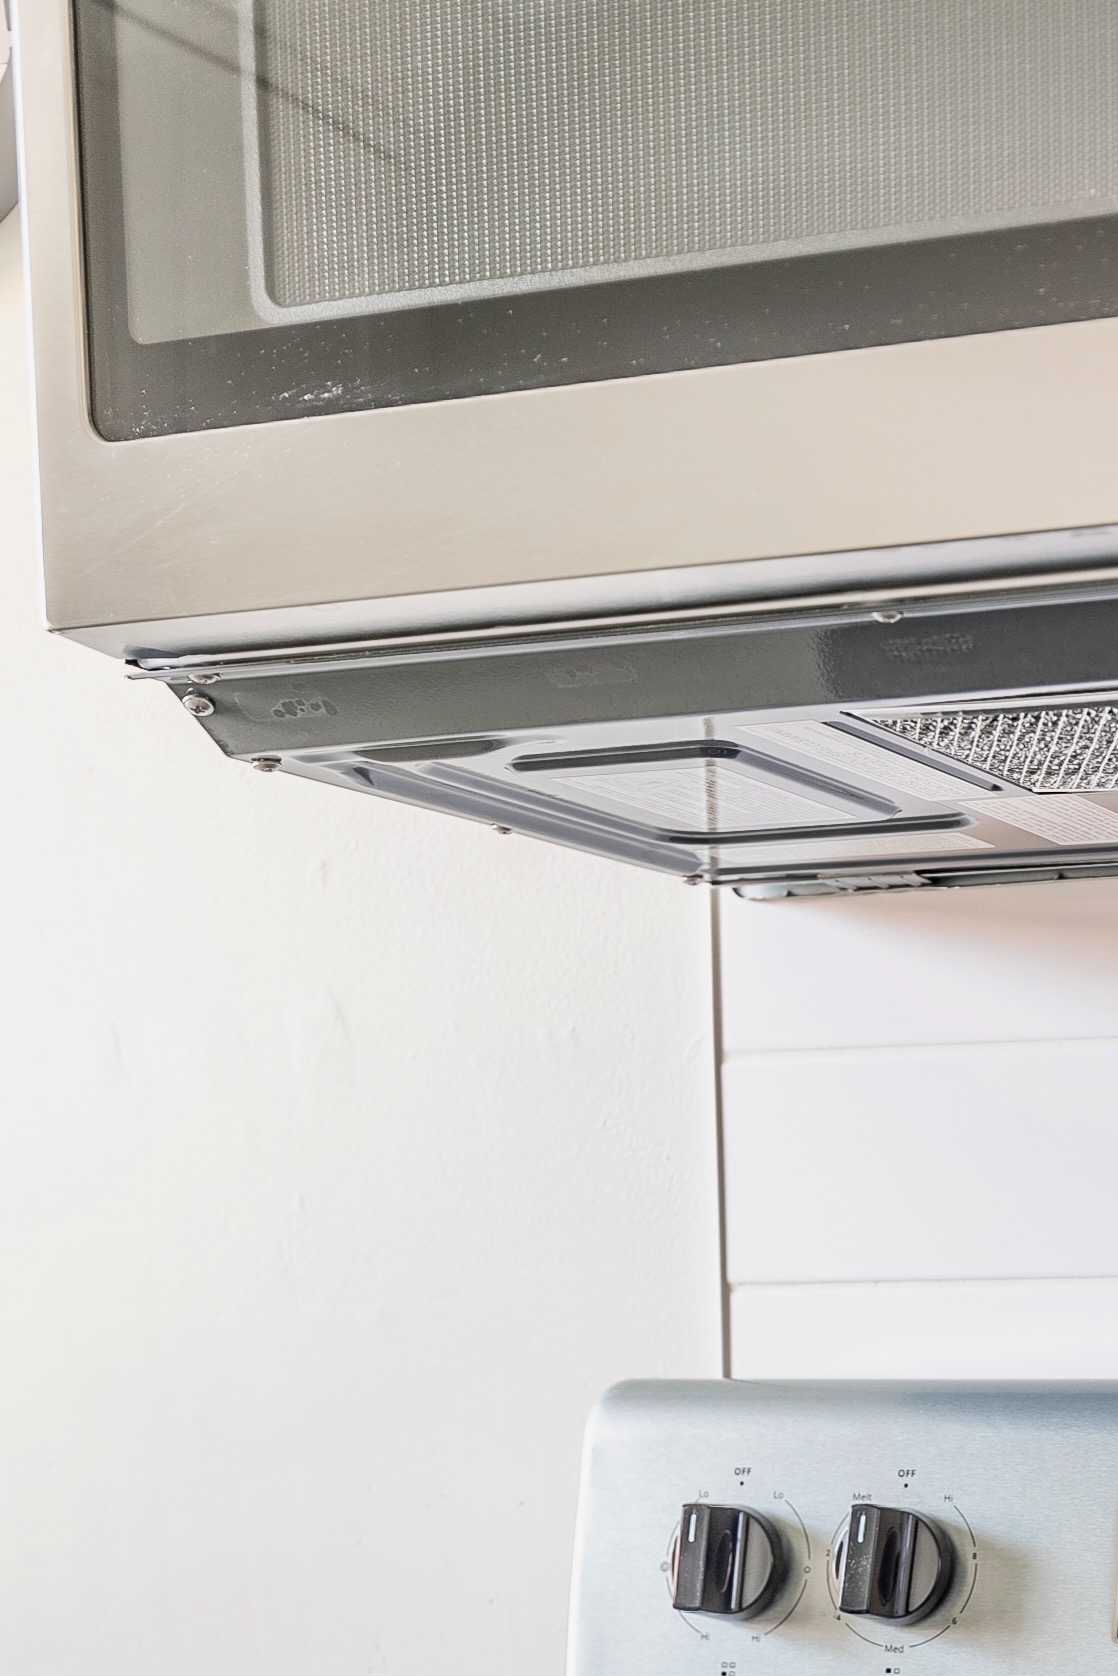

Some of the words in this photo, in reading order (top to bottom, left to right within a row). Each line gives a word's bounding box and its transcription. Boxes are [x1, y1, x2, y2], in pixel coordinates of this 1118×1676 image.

[734, 1467, 752, 1476] OFF
[898, 1469, 916, 1478] OFF
[853, 1492, 872, 1501] Melt
[884, 1644, 904, 1653] Med
